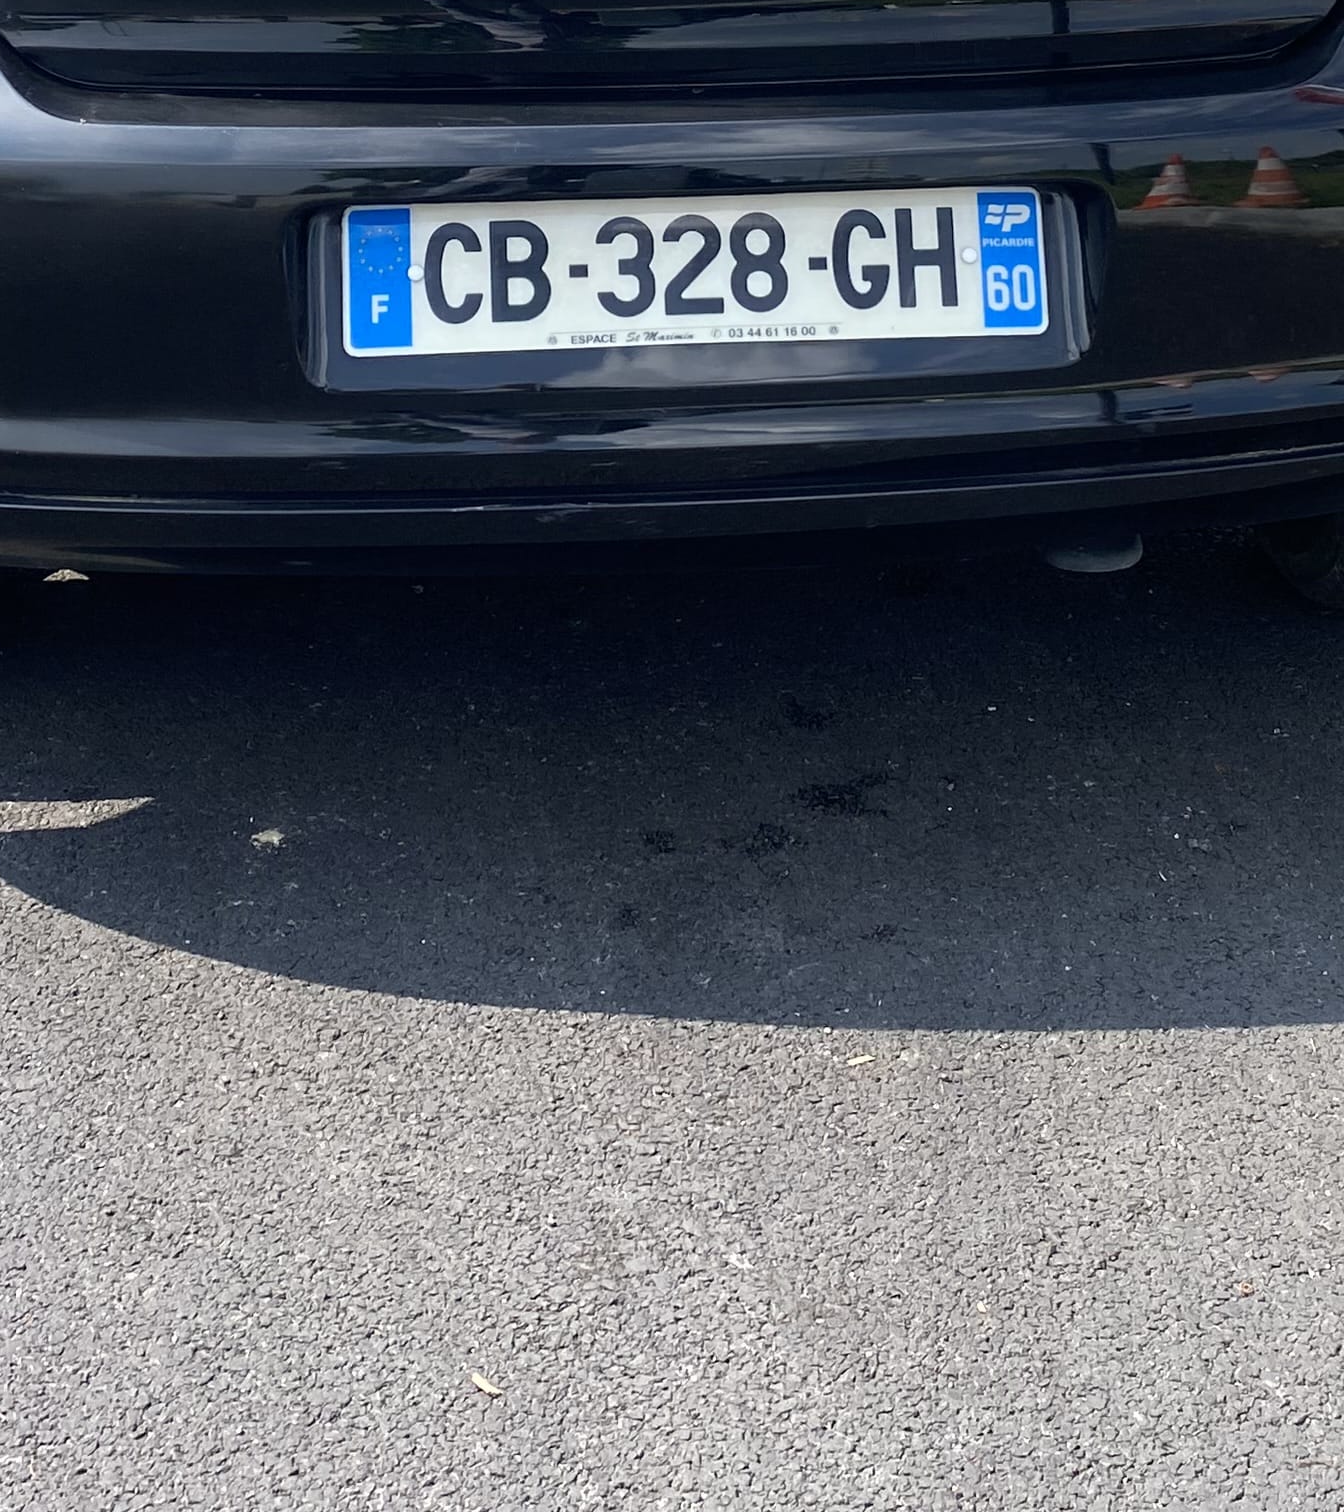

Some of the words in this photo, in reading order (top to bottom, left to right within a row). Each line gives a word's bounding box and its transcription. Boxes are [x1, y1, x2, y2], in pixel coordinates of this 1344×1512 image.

[982, 237, 1035, 248] PICARDIE
[424, 206, 959, 324] CB-328-GH
[986, 263, 1036, 312] 60
[371, 294, 390, 325] F
[571, 333, 617, 345] ESPACE
[728, 327, 744, 338] 03
[747, 327, 762, 337] 44
[765, 327, 779, 337] 61
[785, 327, 798, 337] 16
[801, 326, 816, 336] 00
